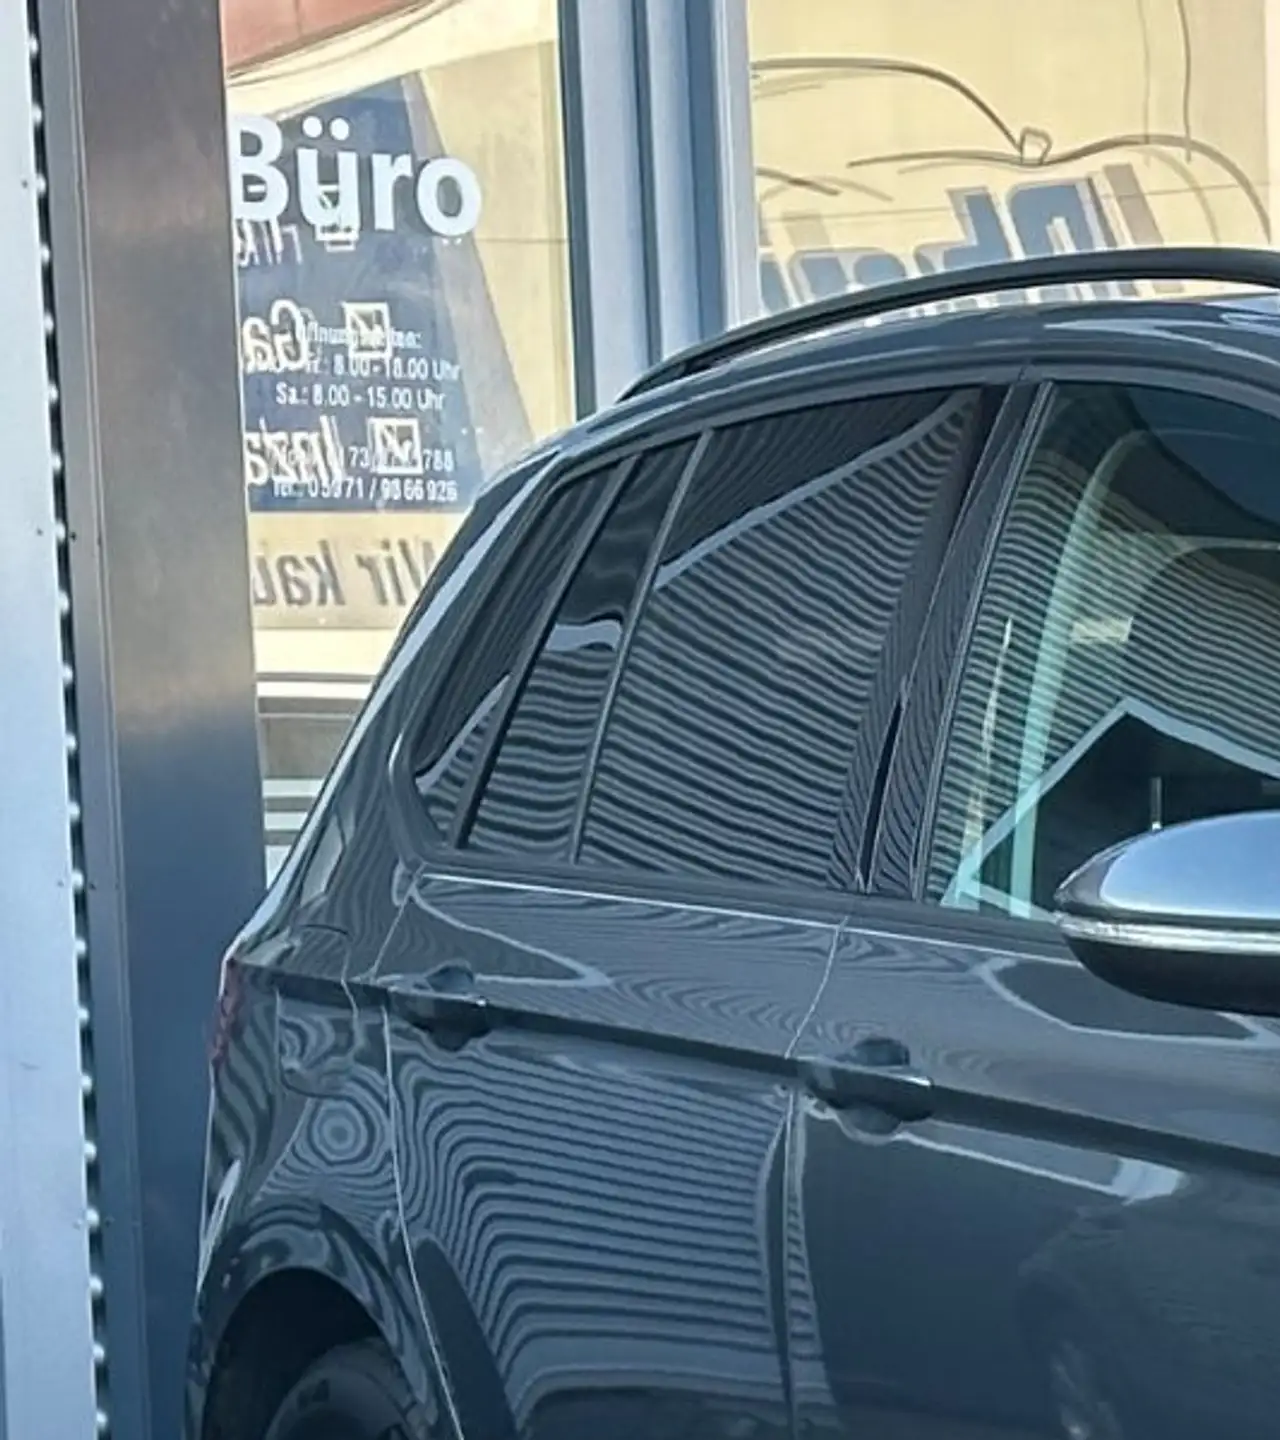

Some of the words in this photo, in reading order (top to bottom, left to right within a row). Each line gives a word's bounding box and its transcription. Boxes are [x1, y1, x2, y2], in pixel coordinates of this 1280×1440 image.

[229, 113, 482, 237] Büro
[432, 358, 460, 381] Uhr
[312, 383, 349, 407] 8.00
[367, 385, 411, 410] 15.00
[416, 387, 446, 410] Uhr
